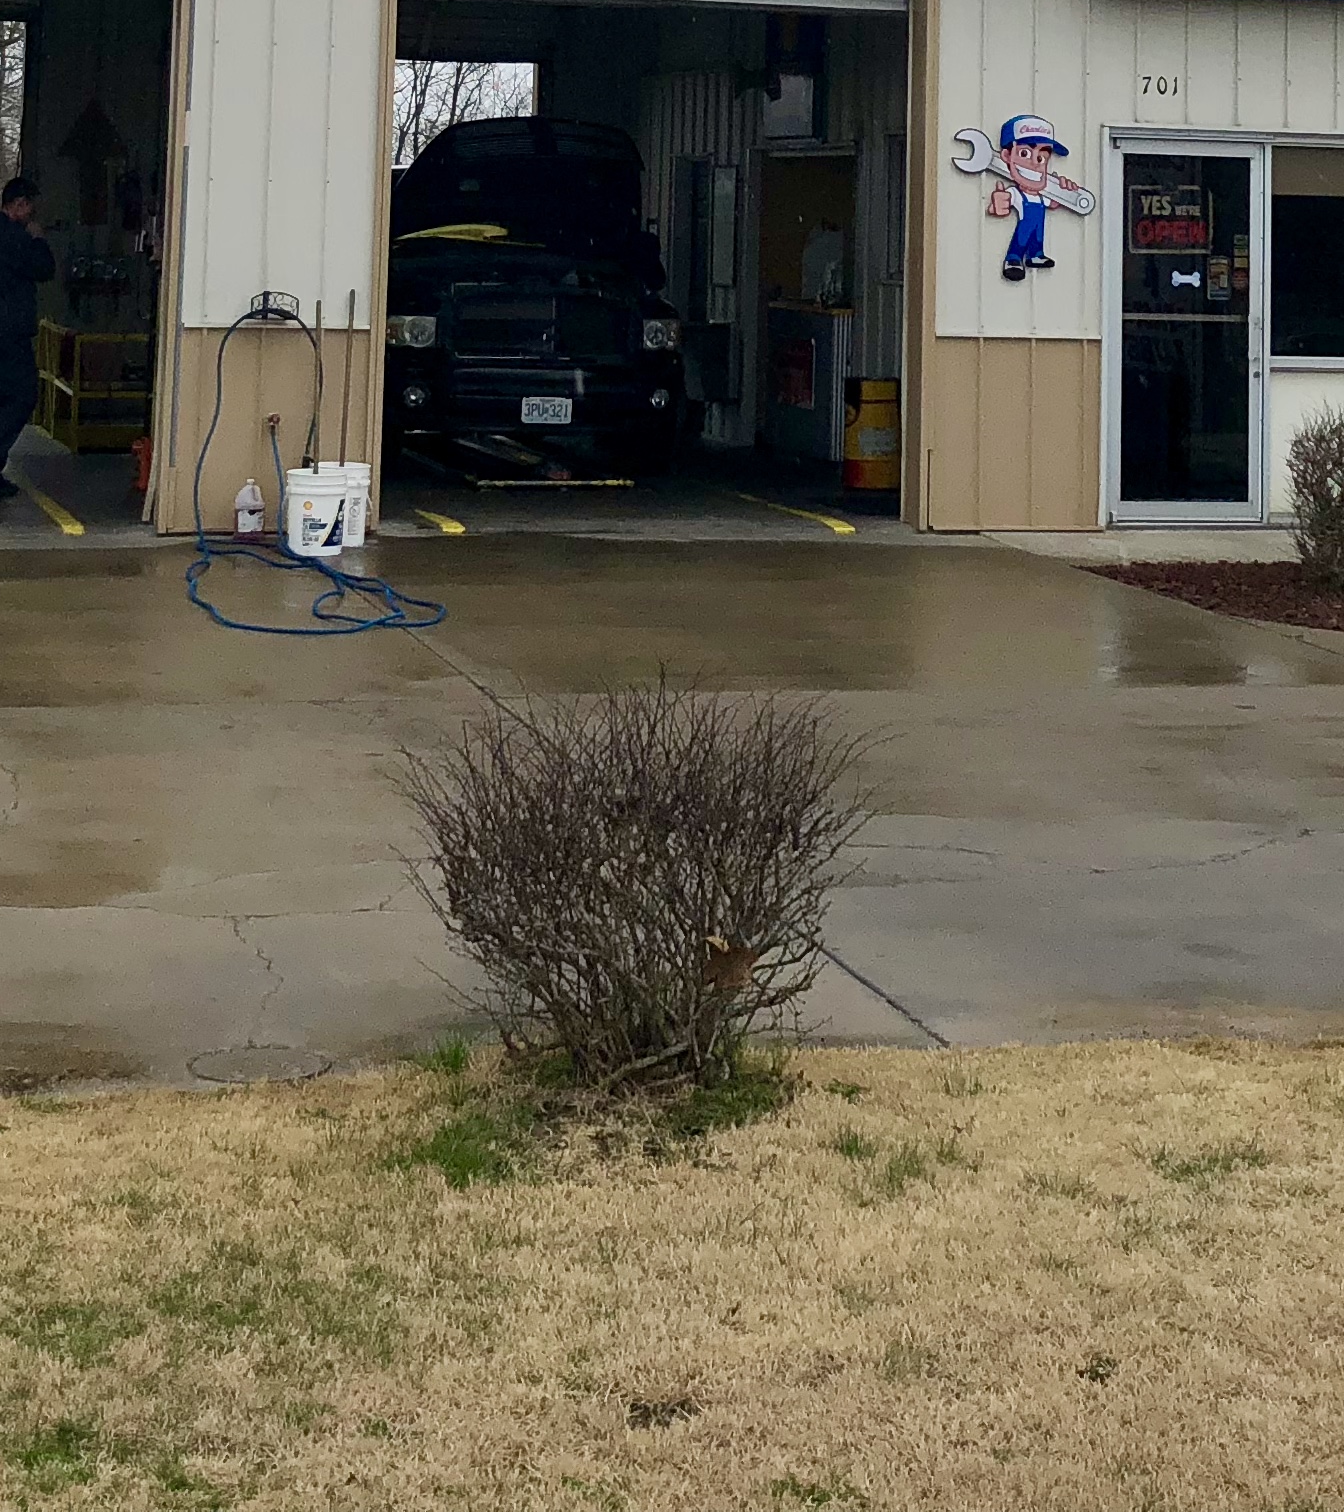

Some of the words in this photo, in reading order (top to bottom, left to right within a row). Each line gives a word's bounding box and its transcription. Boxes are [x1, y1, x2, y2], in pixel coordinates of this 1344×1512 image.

[1141, 75, 1179, 97] 701
[1141, 195, 1172, 217] YES
[1137, 219, 1207, 245] OPEN
